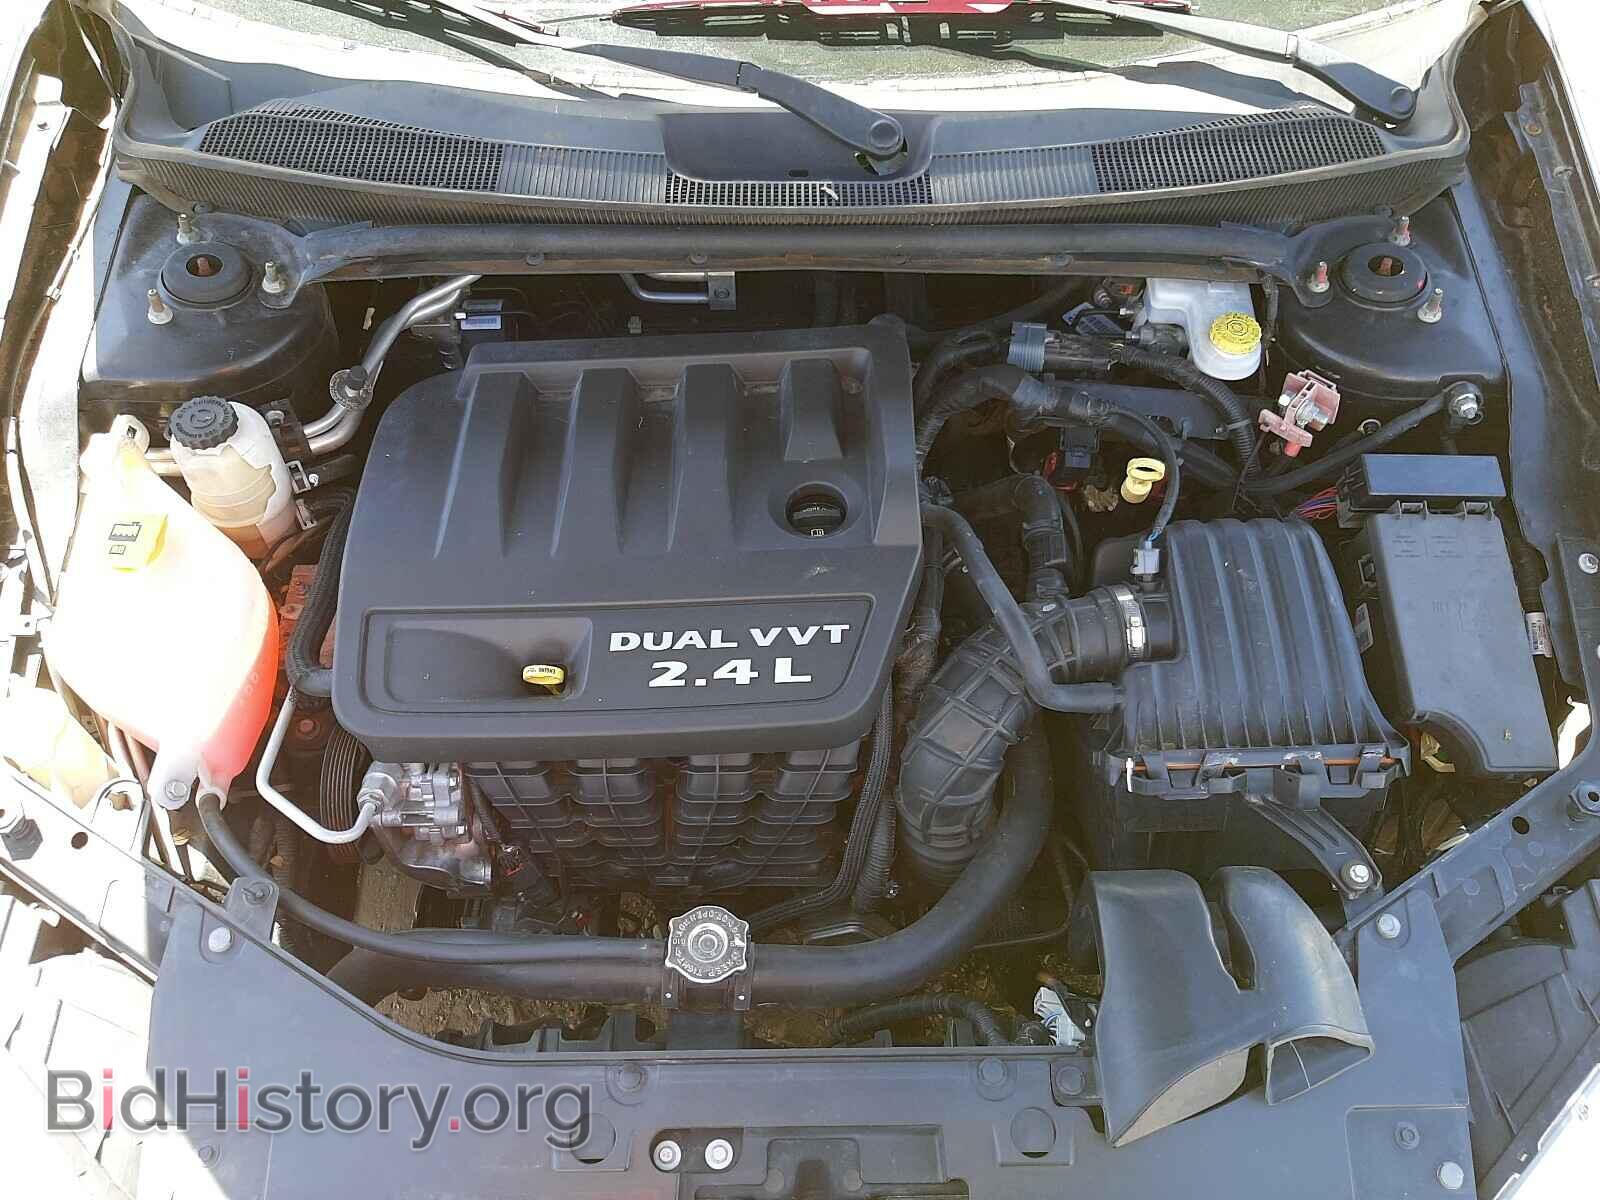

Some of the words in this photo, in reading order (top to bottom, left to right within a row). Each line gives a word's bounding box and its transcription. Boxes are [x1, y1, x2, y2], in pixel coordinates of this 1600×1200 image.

[609, 629, 739, 652] DUAL
[749, 624, 851, 647] VVT
[648, 658, 759, 688] 2.4
[774, 657, 812, 684] L
